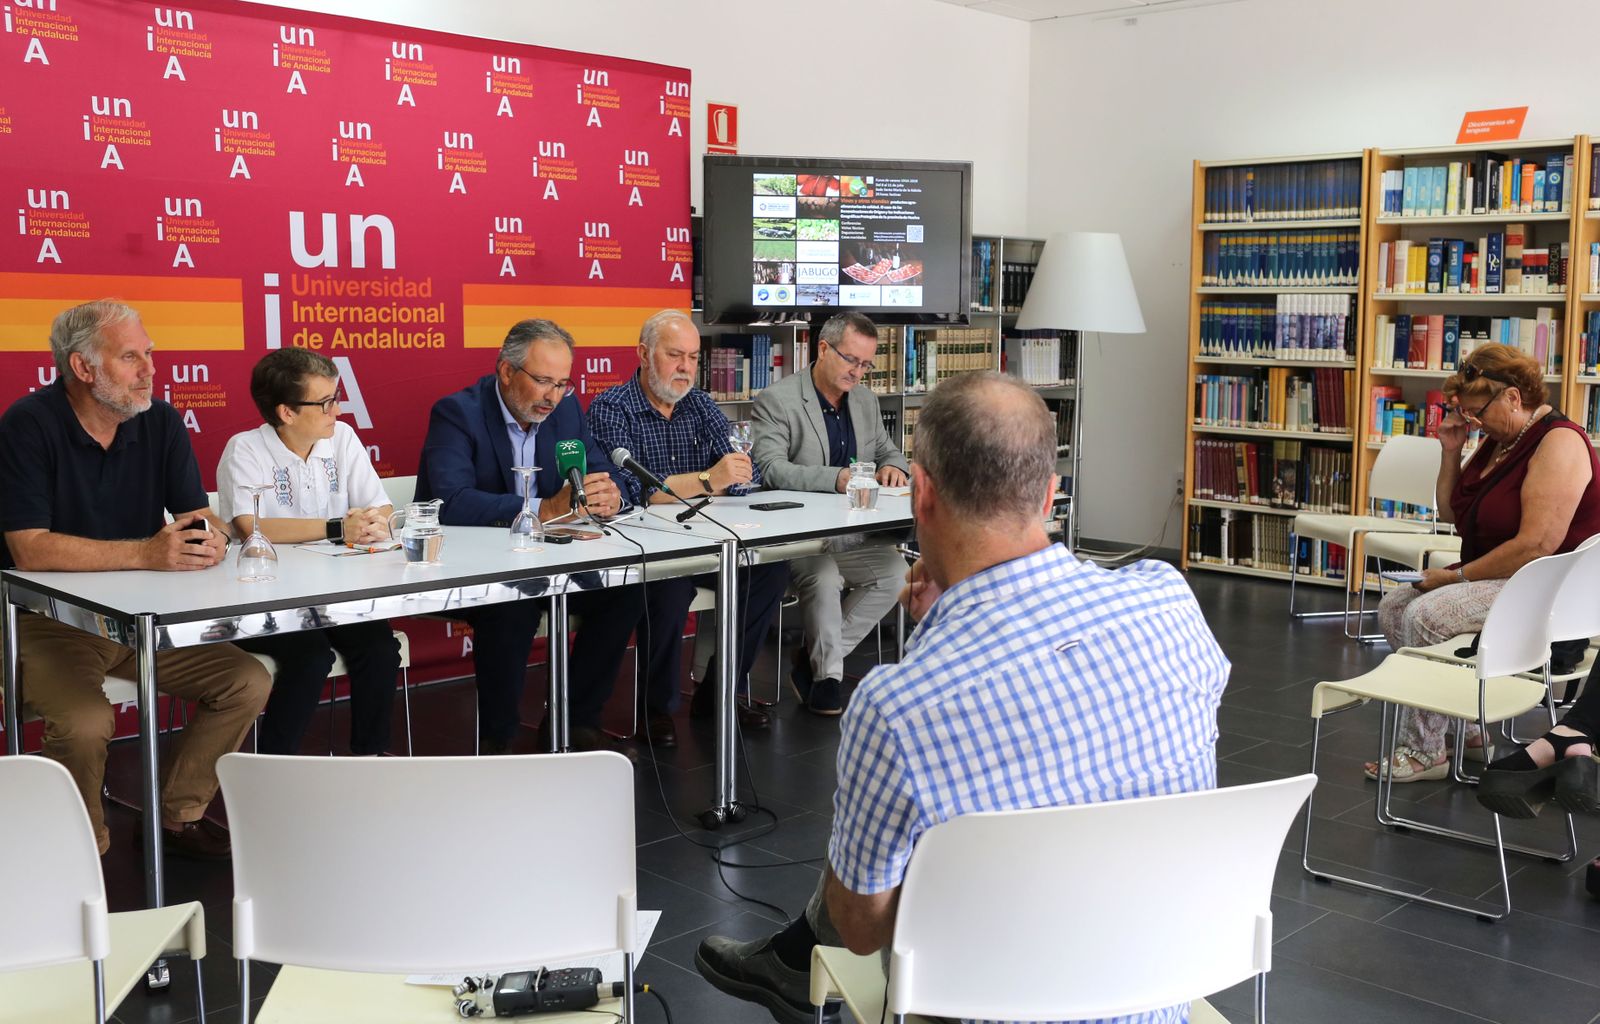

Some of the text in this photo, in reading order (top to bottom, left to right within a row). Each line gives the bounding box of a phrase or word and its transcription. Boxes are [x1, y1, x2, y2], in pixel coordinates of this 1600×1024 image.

[4, 6, 12, 32] i
[16, 9, 72, 22] Universidad
[16, 17, 78, 31] Internacional
[154, 8, 194, 30] un
[16, 26, 78, 41] de Andalucía
[146, 26, 154, 50] i
[156, 28, 207, 41] Universidad
[156, 36, 211, 50] Internacional
[280, 26, 314, 46] un
[24, 38, 50, 64] A
[170, 46, 211, 59] Andalucía
[272, 42, 278, 66] i
[281, 45, 326, 56] Universidad
[281, 53, 330, 64] Internacional
[392, 42, 422, 62] un
[164, 56, 186, 82] A
[293, 62, 330, 72] Andalucía
[386, 58, 390, 80] i
[393, 68, 437, 79] Internacional
[492, 56, 520, 74] un
[286, 70, 308, 94] A
[486, 72, 492, 92] i
[584, 68, 608, 86] un
[396, 84, 416, 106] A
[576, 84, 582, 104] i
[666, 80, 689, 97] un
[92, 96, 132, 118] un
[496, 96, 514, 118] A
[660, 95, 664, 114] i
[82, 114, 90, 140] i
[93, 116, 144, 128] Universidad
[222, 110, 258, 130] un
[586, 106, 602, 128] A
[668, 116, 682, 136] A
[93, 125, 150, 137] Internacional
[108, 134, 151, 145] Andalucía
[214, 128, 222, 152] i
[224, 129, 271, 139] Universidad
[340, 120, 372, 140] un
[224, 137, 276, 148] Internacional
[236, 146, 276, 156] Andalucía
[332, 138, 338, 160] i
[444, 132, 474, 150] un
[538, 140, 566, 158] un
[100, 144, 124, 170] A
[340, 147, 386, 157] Internacional
[438, 148, 442, 170] i
[445, 156, 486, 165] Internacional
[624, 150, 648, 166] un
[230, 154, 250, 180] A
[346, 164, 364, 186] A
[532, 156, 538, 178] i
[620, 164, 624, 184] i
[450, 172, 466, 194] A
[544, 180, 558, 200] A
[28, 188, 70, 210] un
[628, 186, 642, 206] A
[29, 209, 84, 219] Universidad
[164, 198, 202, 216] un
[18, 208, 26, 234] i
[29, 218, 90, 229] Internacional
[156, 216, 164, 240] i
[166, 217, 214, 225] Universidad
[166, 225, 219, 234] Internacional
[494, 216, 522, 234] un
[584, 222, 610, 238] un
[44, 228, 90, 238] Andalucía
[179, 234, 220, 243] Andalucía
[289, 210, 396, 270] un
[488, 232, 494, 254] i
[666, 228, 690, 242] un
[36, 238, 62, 264] A
[172, 244, 194, 268] A
[579, 237, 584, 258] i
[661, 241, 666, 261] i
[500, 256, 516, 276] A
[588, 260, 604, 280] A
[670, 262, 684, 282] A
[798, 267, 838, 277] JABUGO
[291, 273, 432, 298] Universidad
[264, 272, 282, 350] i
[292, 300, 445, 323] Internacional
[292, 326, 446, 349] de Andalucía
[172, 364, 208, 382] un
[586, 358, 610, 372] un
[38, 366, 56, 386] u
[580, 374, 585, 394] i
[174, 392, 225, 400] Internacional
[186, 400, 225, 408] Andalucía
[183, 410, 200, 432] A
